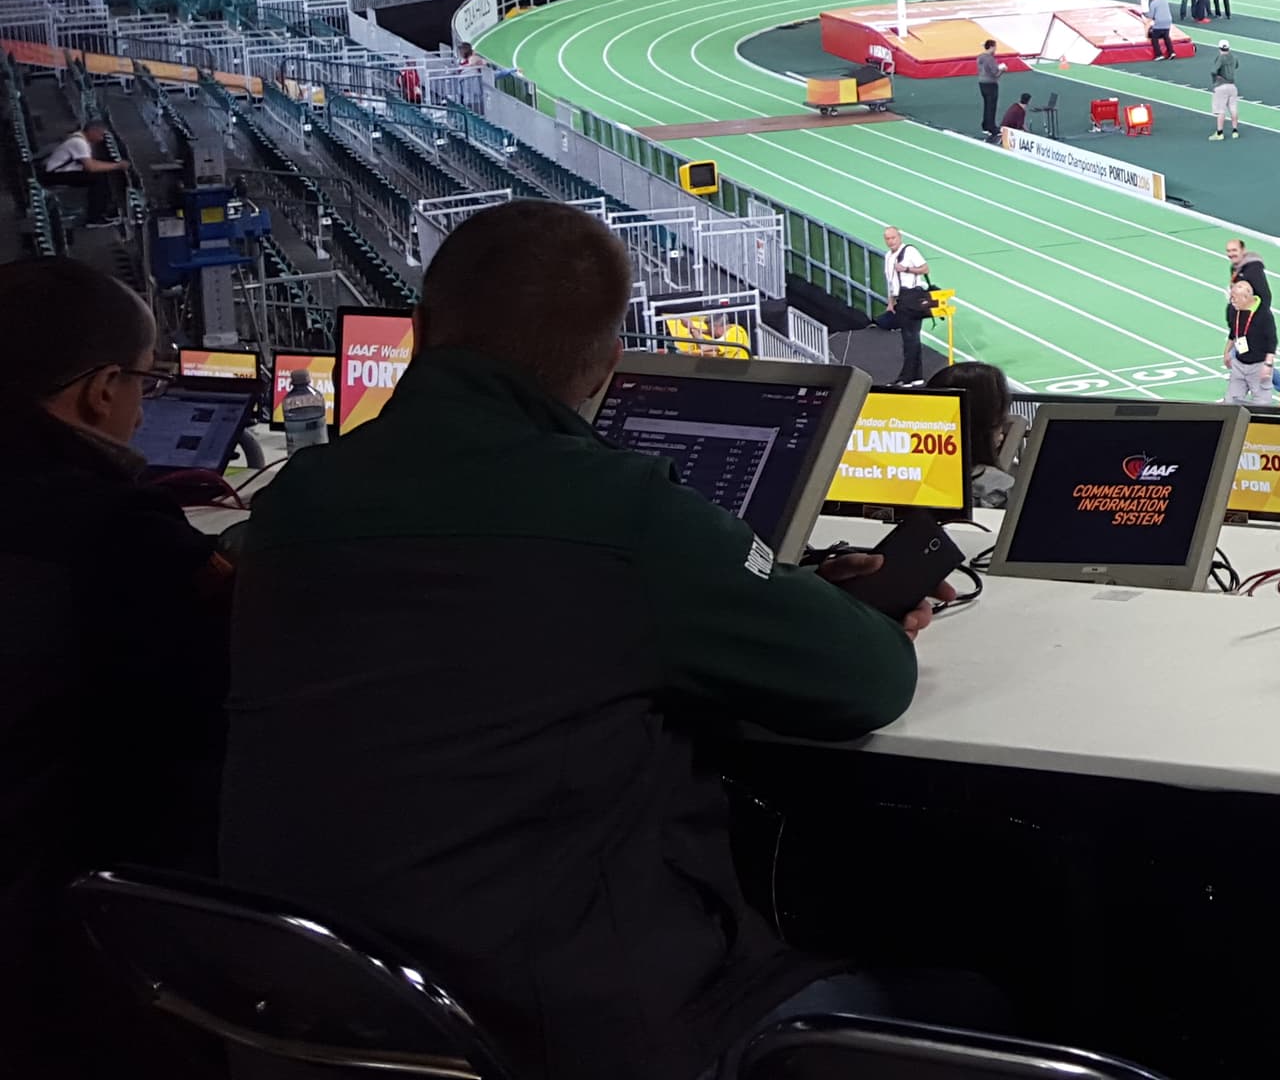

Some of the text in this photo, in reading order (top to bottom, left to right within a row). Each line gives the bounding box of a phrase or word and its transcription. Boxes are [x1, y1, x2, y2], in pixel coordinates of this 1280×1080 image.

[1018, 137, 1035, 152] IAAF
[1036, 143, 1051, 154] World
[347, 344, 409, 358] IAAF World
[858, 416, 957, 432] Indoor Championships
[839, 463, 922, 481] Track PGM
[1142, 464, 1179, 477] IAAF
[1072, 484, 1173, 498] COMMENTATOR
[1241, 480, 1272, 493] PGM
[1077, 498, 1170, 511] INFORMATION
[1111, 511, 1166, 525] SYSTEM
